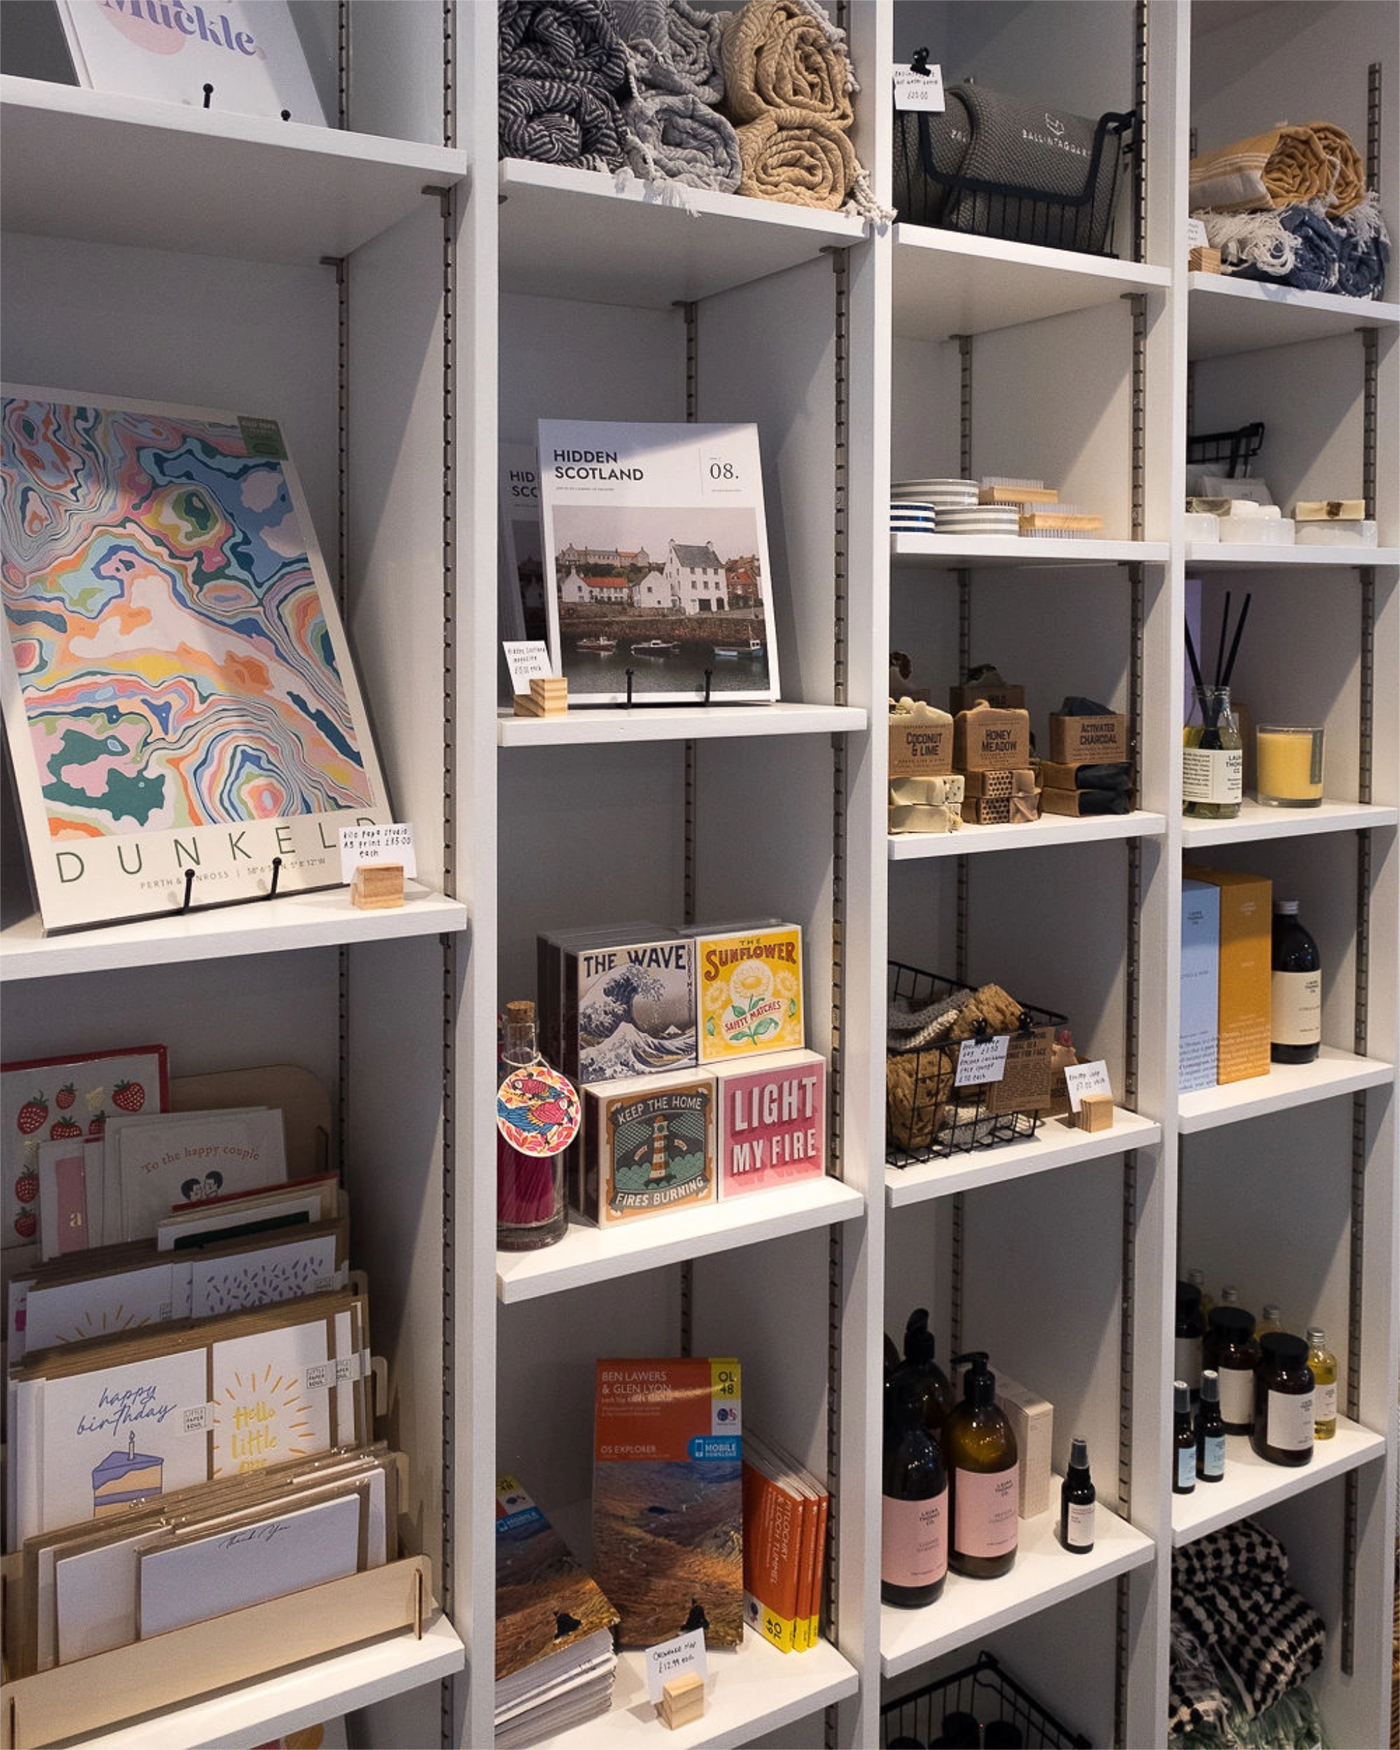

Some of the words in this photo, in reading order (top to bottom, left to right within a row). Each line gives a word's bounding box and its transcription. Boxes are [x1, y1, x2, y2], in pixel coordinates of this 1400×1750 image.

[553, 450, 618, 464] HIDDEN
[555, 466, 644, 481] SCOTLAND
[985, 728, 1012, 741] HONEY
[1081, 723, 1116, 733] ACTIVATED
[906, 732, 943, 745] COCONUT
[1080, 733, 1118, 746] CHARCOAL
[920, 744, 939, 757] LIME
[981, 741, 1018, 753] MEADOW
[139, 879, 173, 890] PERTH
[739, 938, 761, 947] THE
[583, 953, 617, 978] THE
[626, 944, 687, 970] WAVE
[703, 941, 797, 982] SUNFLOWER
[724, 1012, 749, 1032] SAFETY
[750, 1000, 782, 1020] MATCHES
[617, 1103, 645, 1125] KEEP
[647, 1097, 669, 1112] THE
[672, 1096, 703, 1110] HOME
[734, 1076, 818, 1131] LIGHT
[732, 1139, 764, 1174] MY
[771, 1128, 817, 1166] FIRE
[141, 1160, 160, 1174] To
[162, 1152, 181, 1167] the
[184, 1144, 220, 1161] happy
[223, 1145, 260, 1161] couple
[614, 1193, 649, 1208] FIRES
[653, 1176, 704, 1207] BURNING
[69, 1211, 82, 1228] a
[601, 1371, 623, 1381] BEN
[625, 1371, 668, 1382] LAWERS
[717, 1371, 736, 1382] OL
[99, 1384, 158, 1409] happy
[601, 1384, 610, 1395] &
[612, 1384, 641, 1395] GLEN
[643, 1384, 673, 1395] LYON
[719, 1384, 735, 1395] 48
[76, 1403, 178, 1437] birthday
[232, 1401, 276, 1431] Hello
[600, 1445, 614, 1454] OS
[614, 1445, 657, 1454] EXPLORER
[704, 1443, 737, 1453] MOBILE
[773, 1505, 783, 1539] LOCH
[781, 1499, 792, 1562] PITLOCHRY
[772, 1622, 782, 1640] OL
